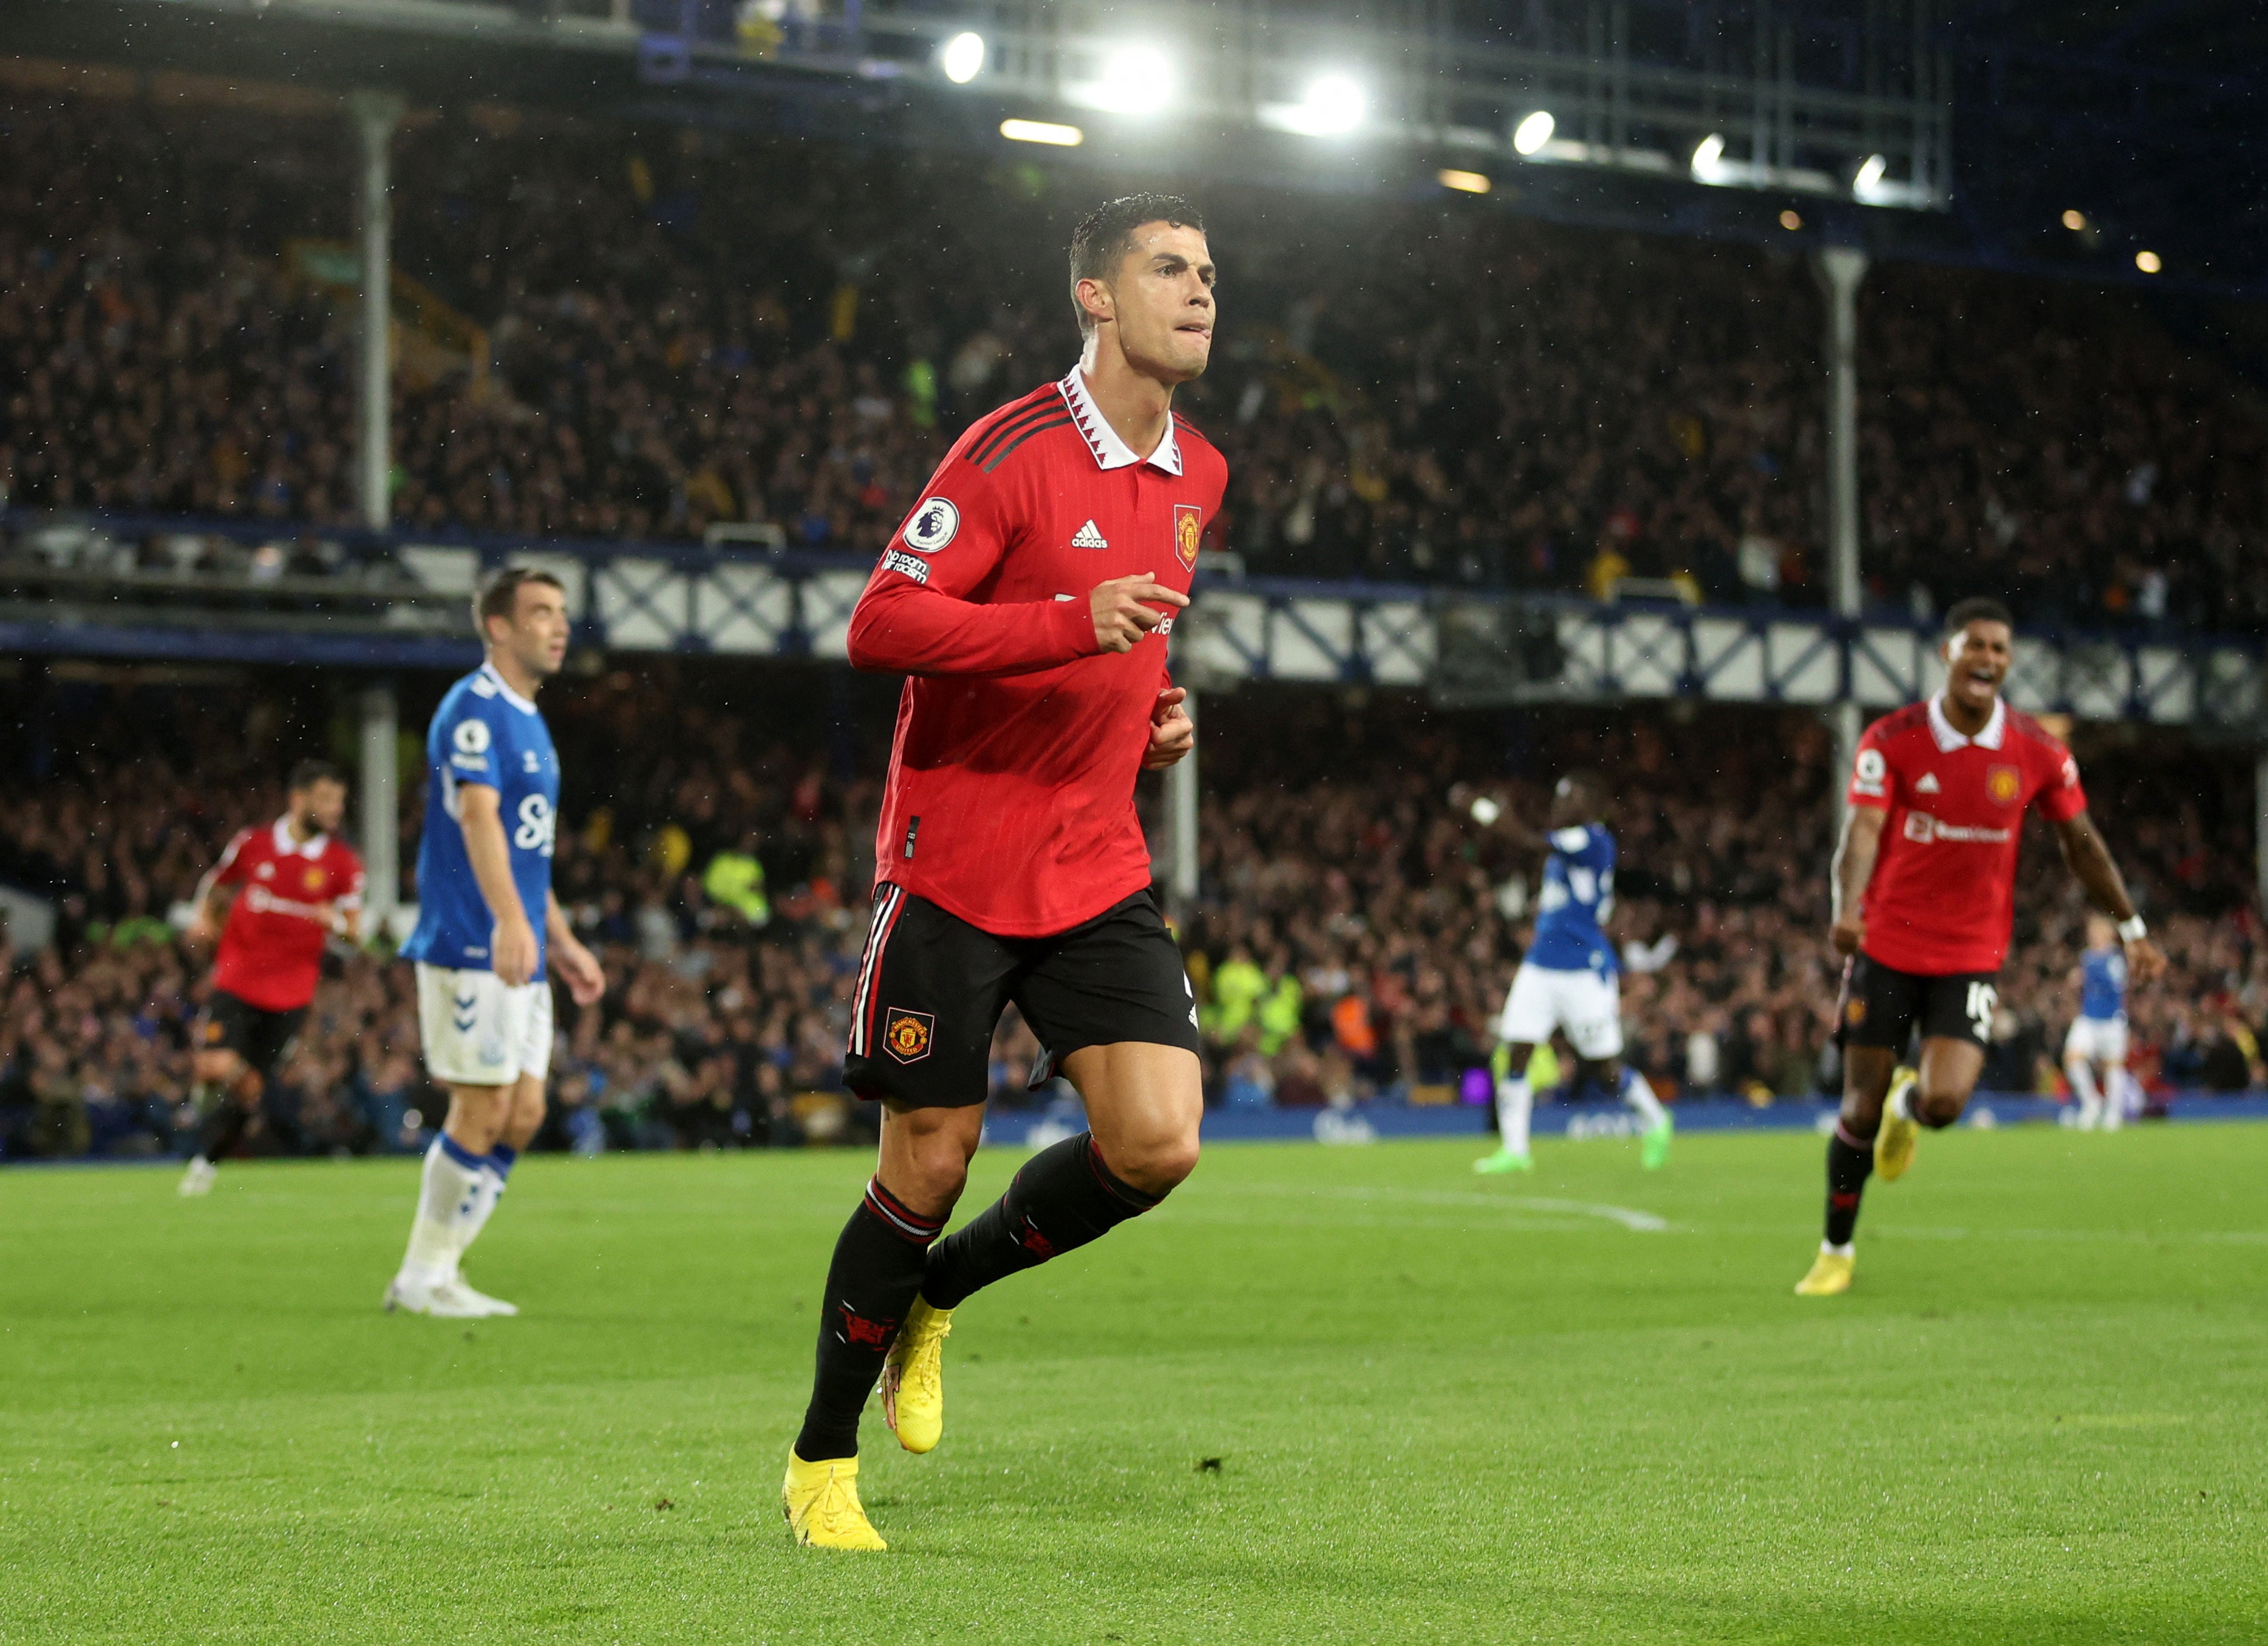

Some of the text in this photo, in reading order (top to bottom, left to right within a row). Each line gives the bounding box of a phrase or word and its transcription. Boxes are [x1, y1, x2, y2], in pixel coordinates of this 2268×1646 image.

[1071, 537, 1108, 548] adidas
[886, 549, 927, 573] No room
[894, 1020, 924, 1034] MANCHESTER
[896, 1044, 918, 1053] UNITED
